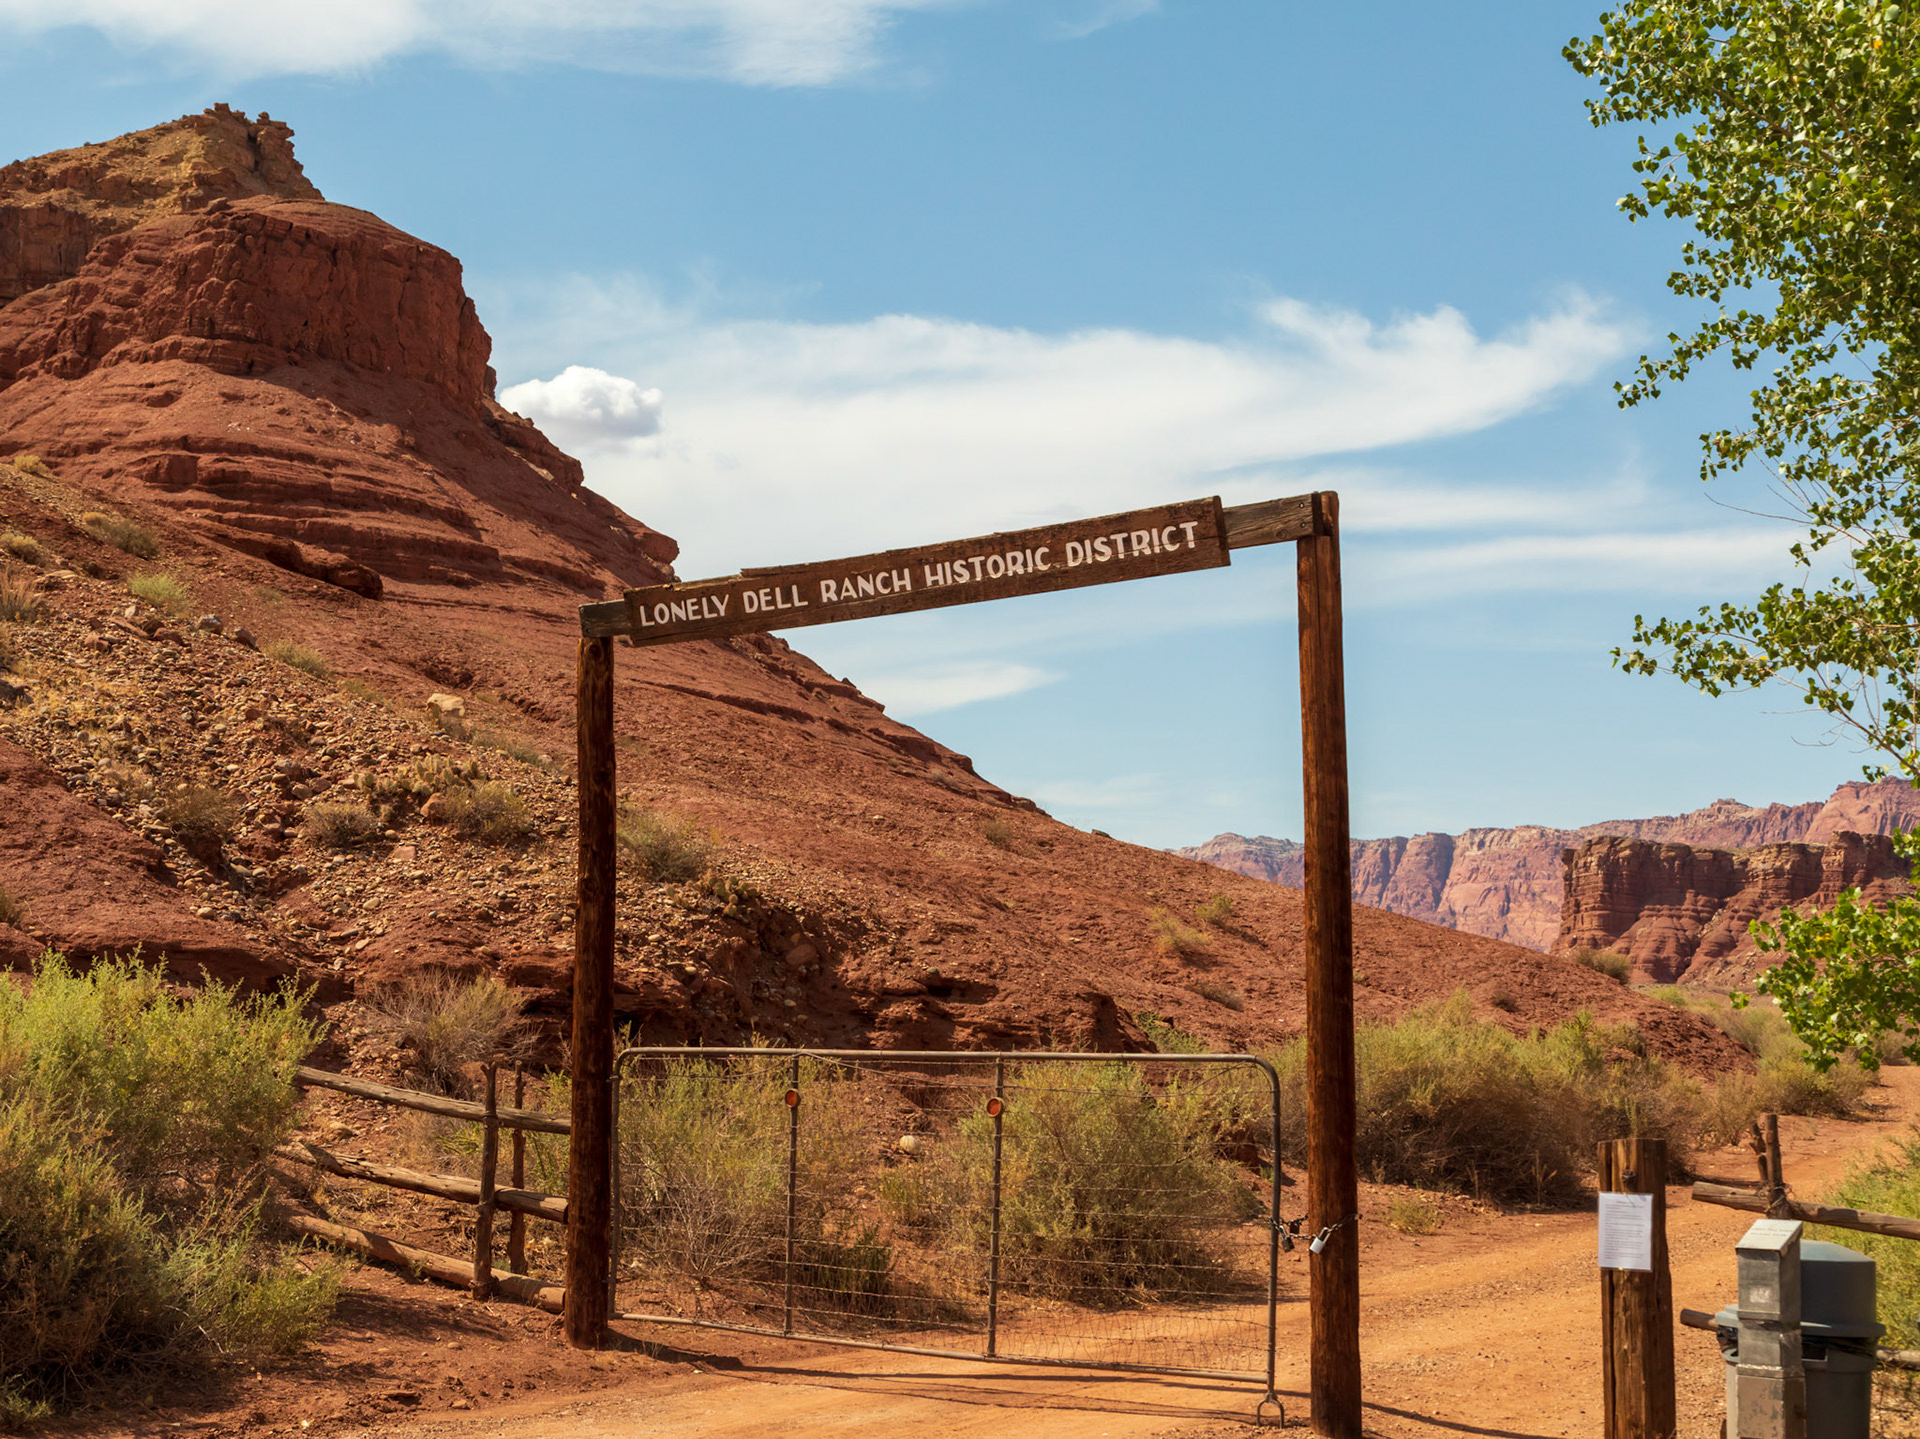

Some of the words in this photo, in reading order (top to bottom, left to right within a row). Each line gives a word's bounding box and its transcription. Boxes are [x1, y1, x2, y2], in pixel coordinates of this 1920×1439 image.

[640, 594, 729, 627] LONELY
[743, 585, 808, 613] DELL
[820, 568, 912, 603] RANCH
[924, 547, 1051, 587] HISTORIC
[1065, 521, 1198, 567] DISTRICT
